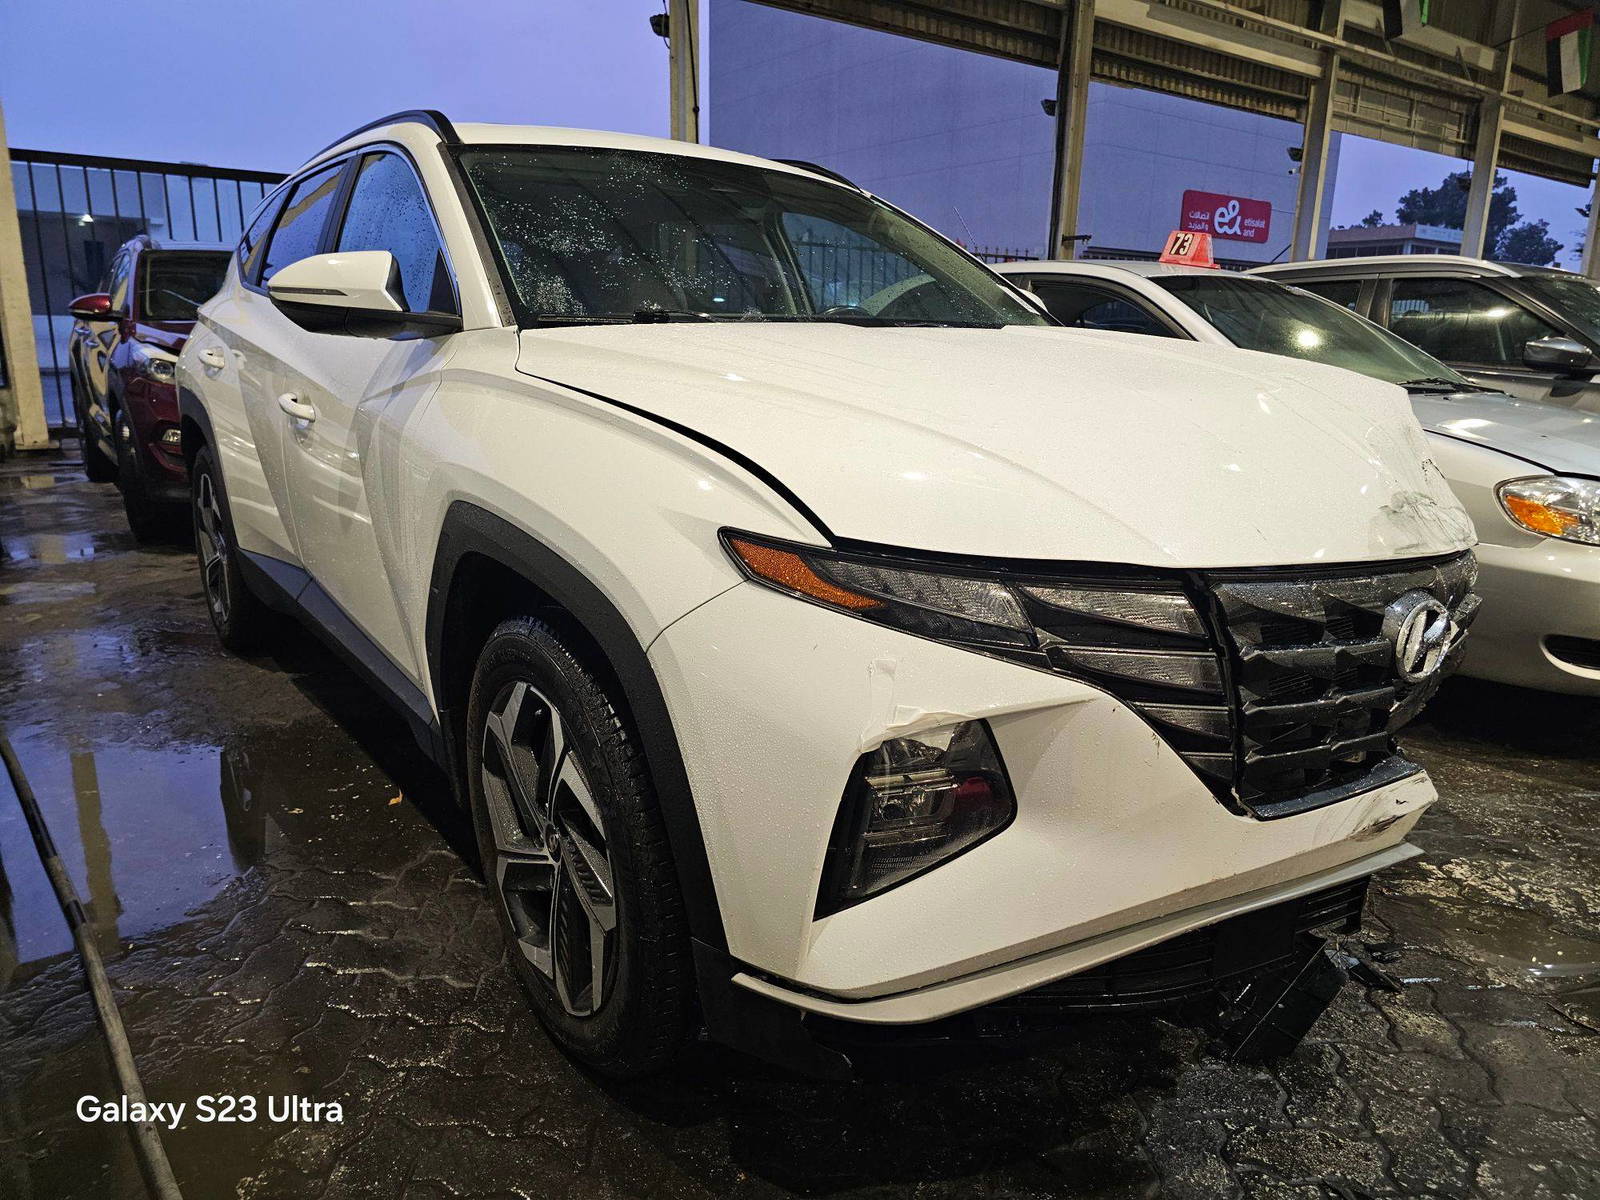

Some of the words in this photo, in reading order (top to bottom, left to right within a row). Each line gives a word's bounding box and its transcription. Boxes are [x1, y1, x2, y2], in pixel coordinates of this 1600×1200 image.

[1244, 218, 1265, 228] etisalat
[1243, 229, 1254, 237] and
[1170, 233, 1193, 255] 73
